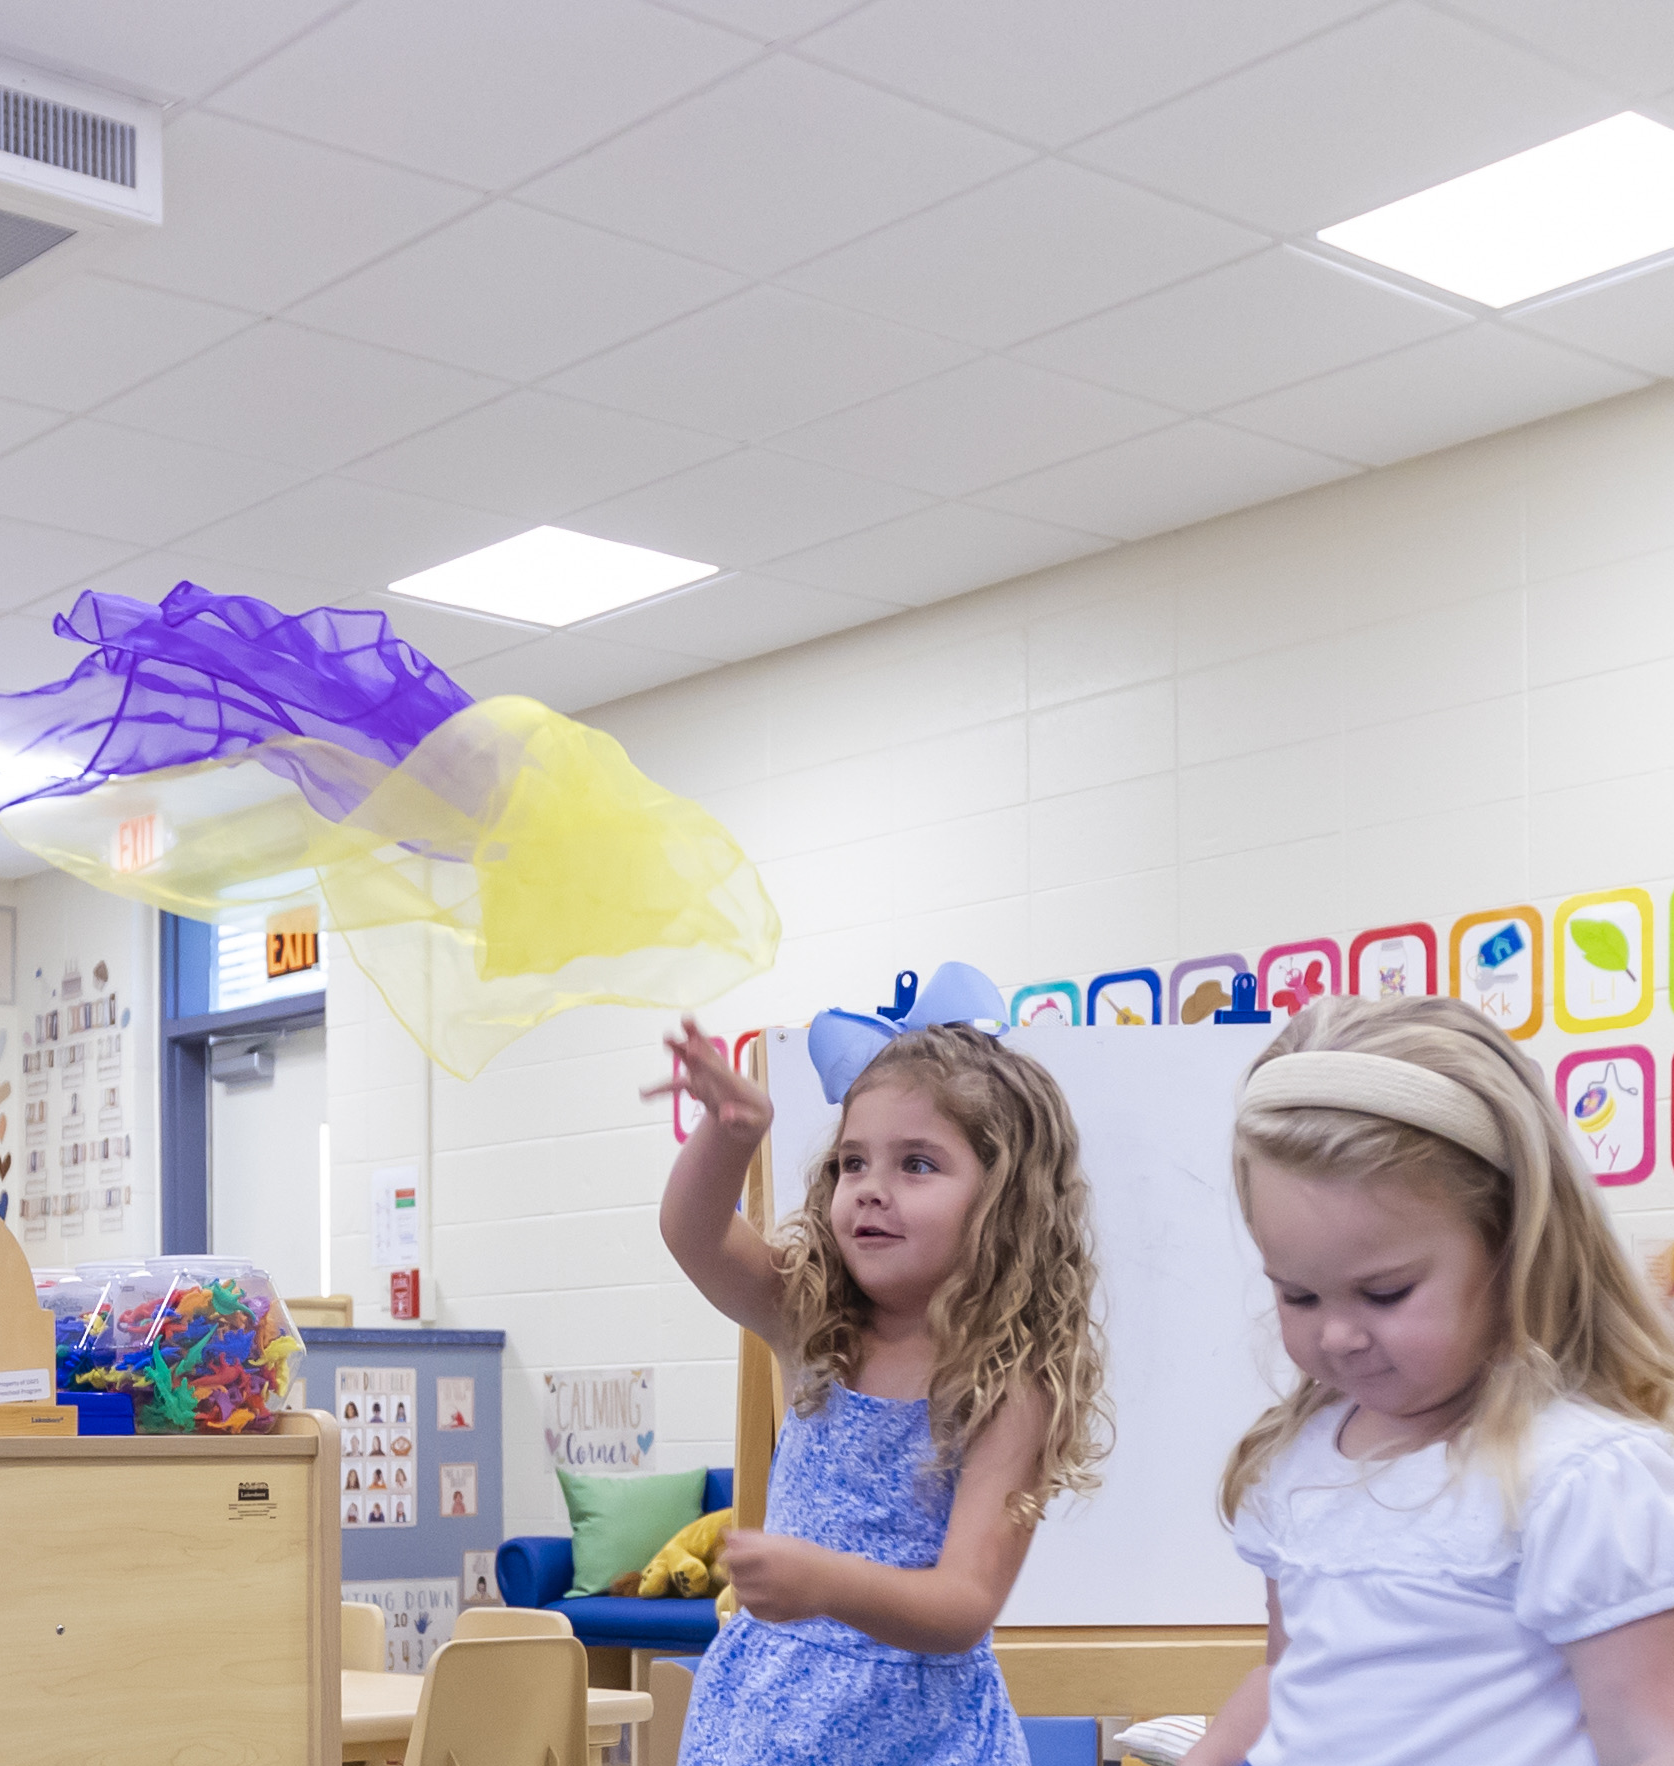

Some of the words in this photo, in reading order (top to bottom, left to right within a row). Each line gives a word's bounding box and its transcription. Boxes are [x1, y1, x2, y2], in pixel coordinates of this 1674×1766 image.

[119, 813, 156, 873] EXIT
[268, 932, 317, 977] EXIT
[1480, 992, 1512, 1016] Kk
[1589, 1133, 1621, 1171] Yy
[557, 1379, 641, 1430] CALMING
[566, 1432, 629, 1465] Corner
[406, 1589, 454, 1611] DOWN
[394, 1613, 408, 1628] 10
